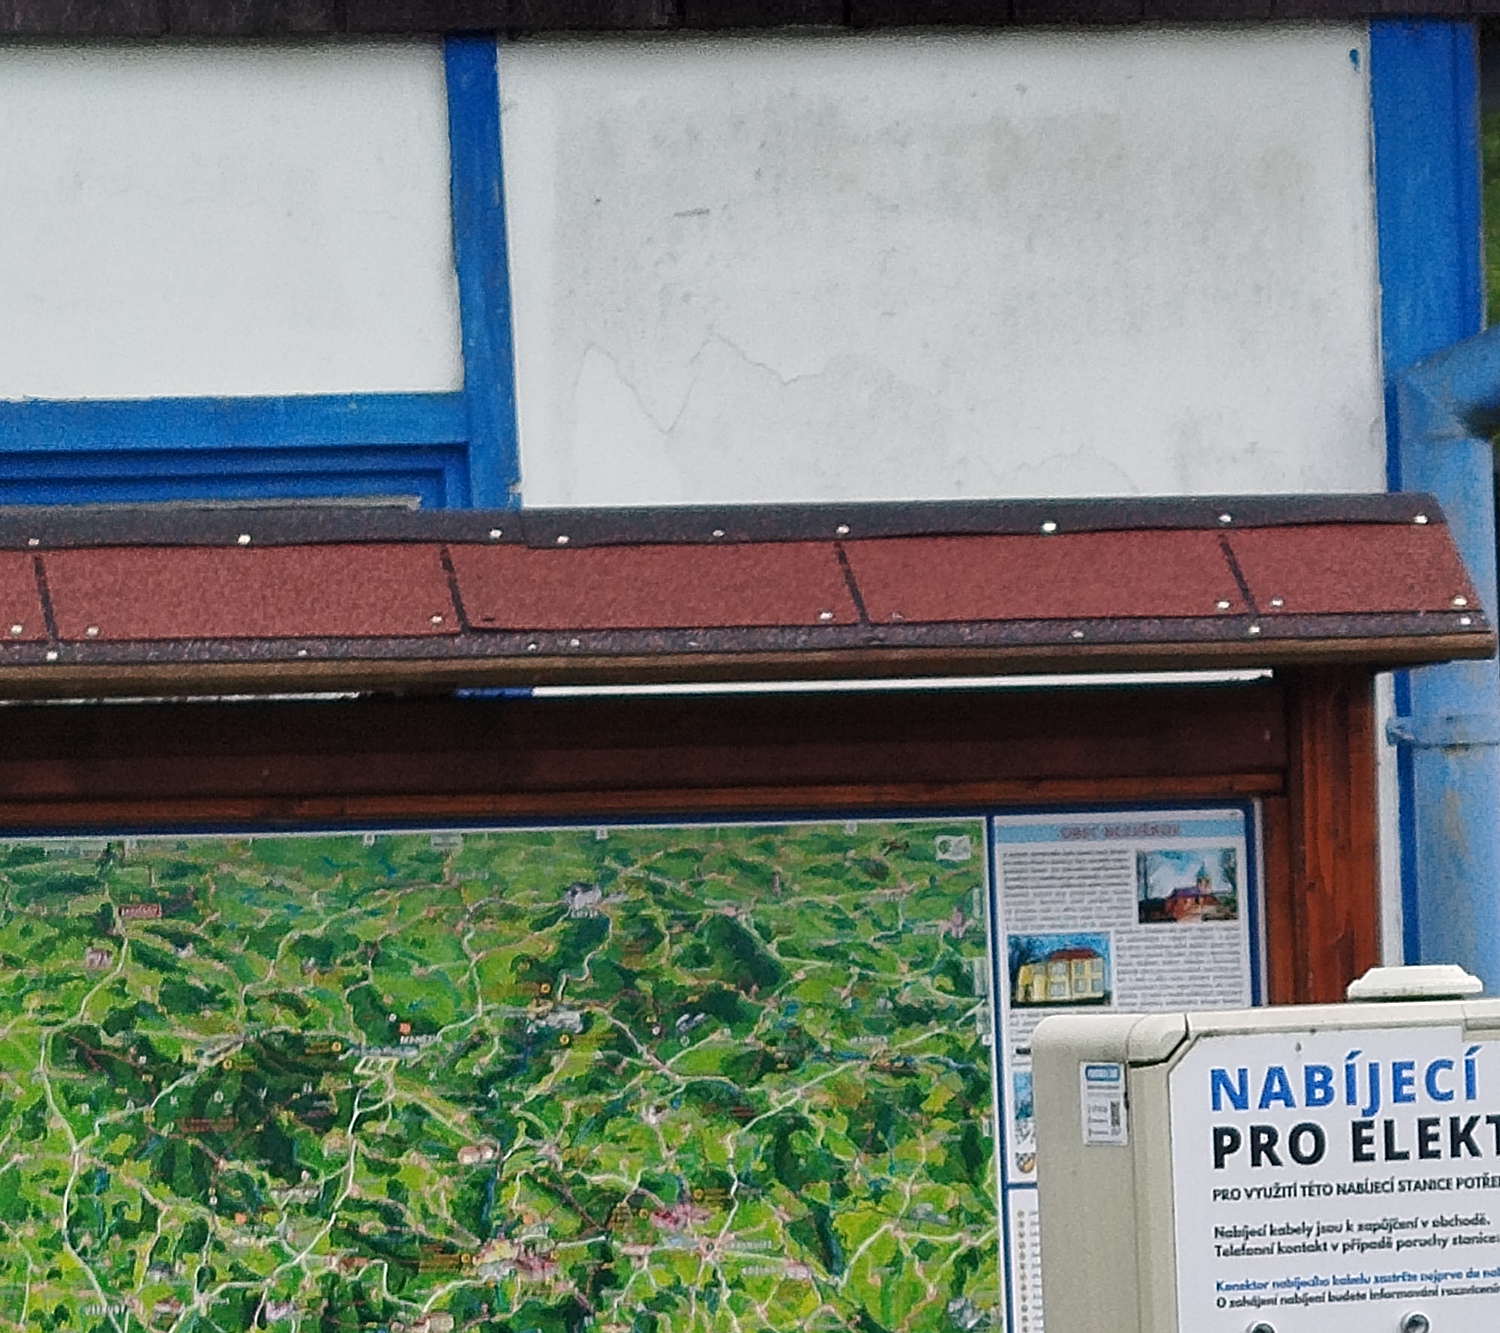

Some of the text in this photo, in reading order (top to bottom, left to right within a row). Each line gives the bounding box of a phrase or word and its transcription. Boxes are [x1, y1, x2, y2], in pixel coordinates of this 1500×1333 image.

[1210, 1045, 1482, 1118] NABÍJECÍ
[1213, 1122, 1327, 1169] PRO
[1212, 1187, 1241, 1201] PRO
[1243, 1181, 1297, 1199] VYUŽITÍ
[1300, 1179, 1333, 1197] TÉTO
[1336, 1175, 1394, 1195] NABÍJECÍ
[1398, 1178, 1452, 1193] STANICE
[1214, 1212, 1491, 1240] Nabíjecí kabely jsou k zapůjčení v obchodě.
[1214, 1242, 1275, 1257] Telefonní
[1277, 1239, 1328, 1254] kontakt
[1331, 1243, 1340, 1252] v
[1342, 1236, 1393, 1254] případě
[1396, 1234, 1448, 1252] poruchy
[1216, 1296, 1227, 1308] O
